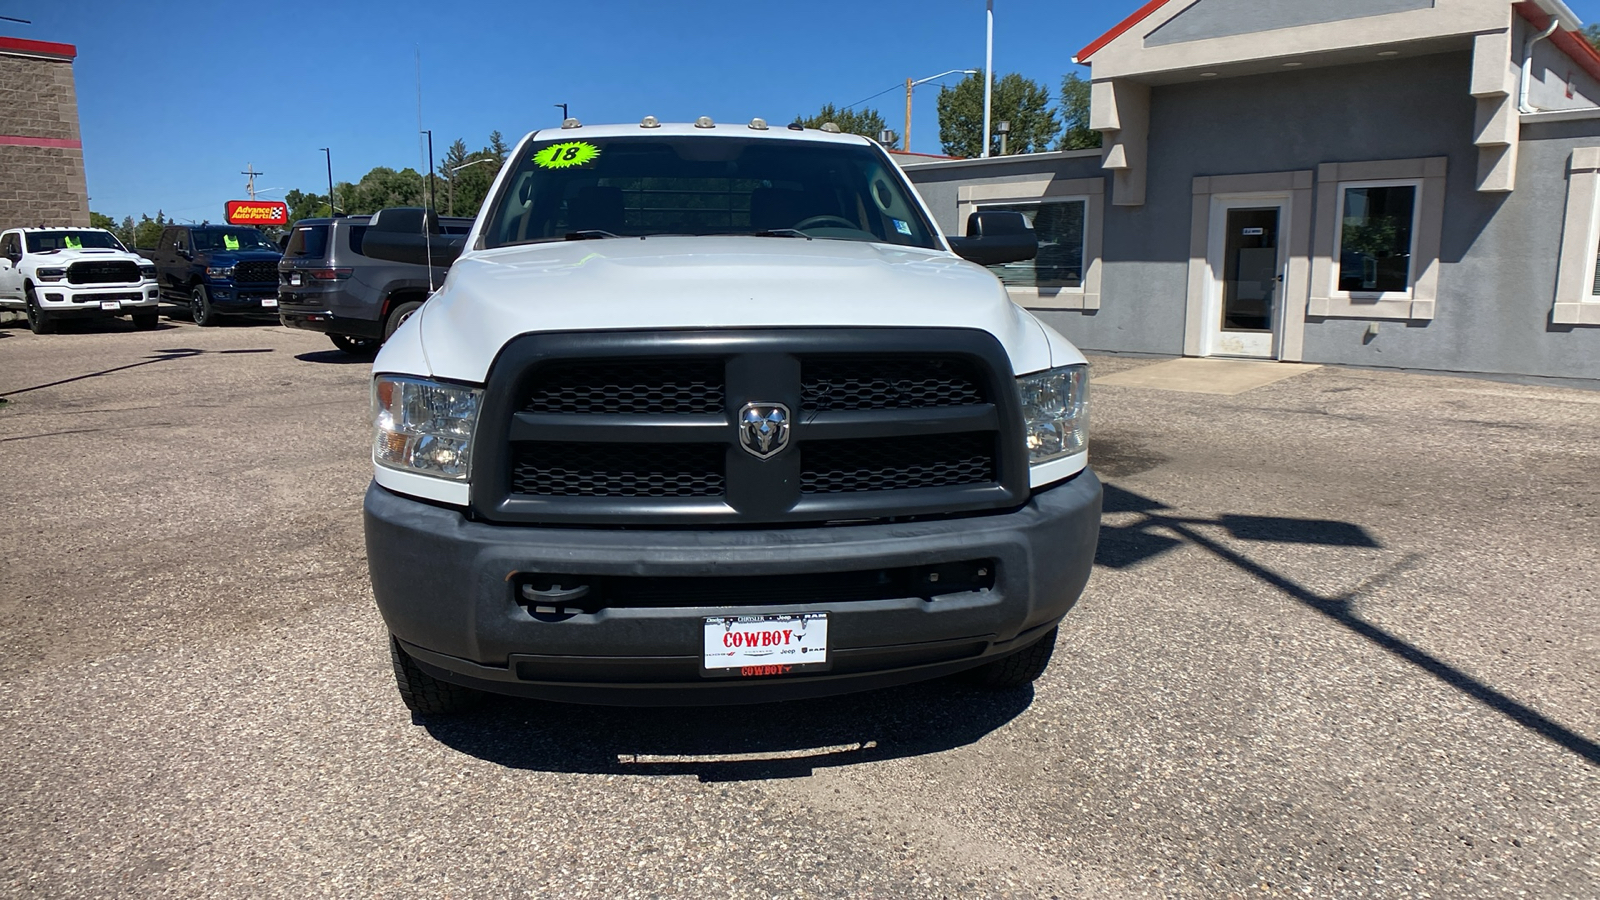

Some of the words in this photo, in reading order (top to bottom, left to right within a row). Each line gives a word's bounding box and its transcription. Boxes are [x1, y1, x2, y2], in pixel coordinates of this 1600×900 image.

[550, 147, 580, 161] 18
[250, 211, 269, 219] Parts
[723, 630, 793, 647] COWBOY
[741, 665, 783, 676] COWBOY
